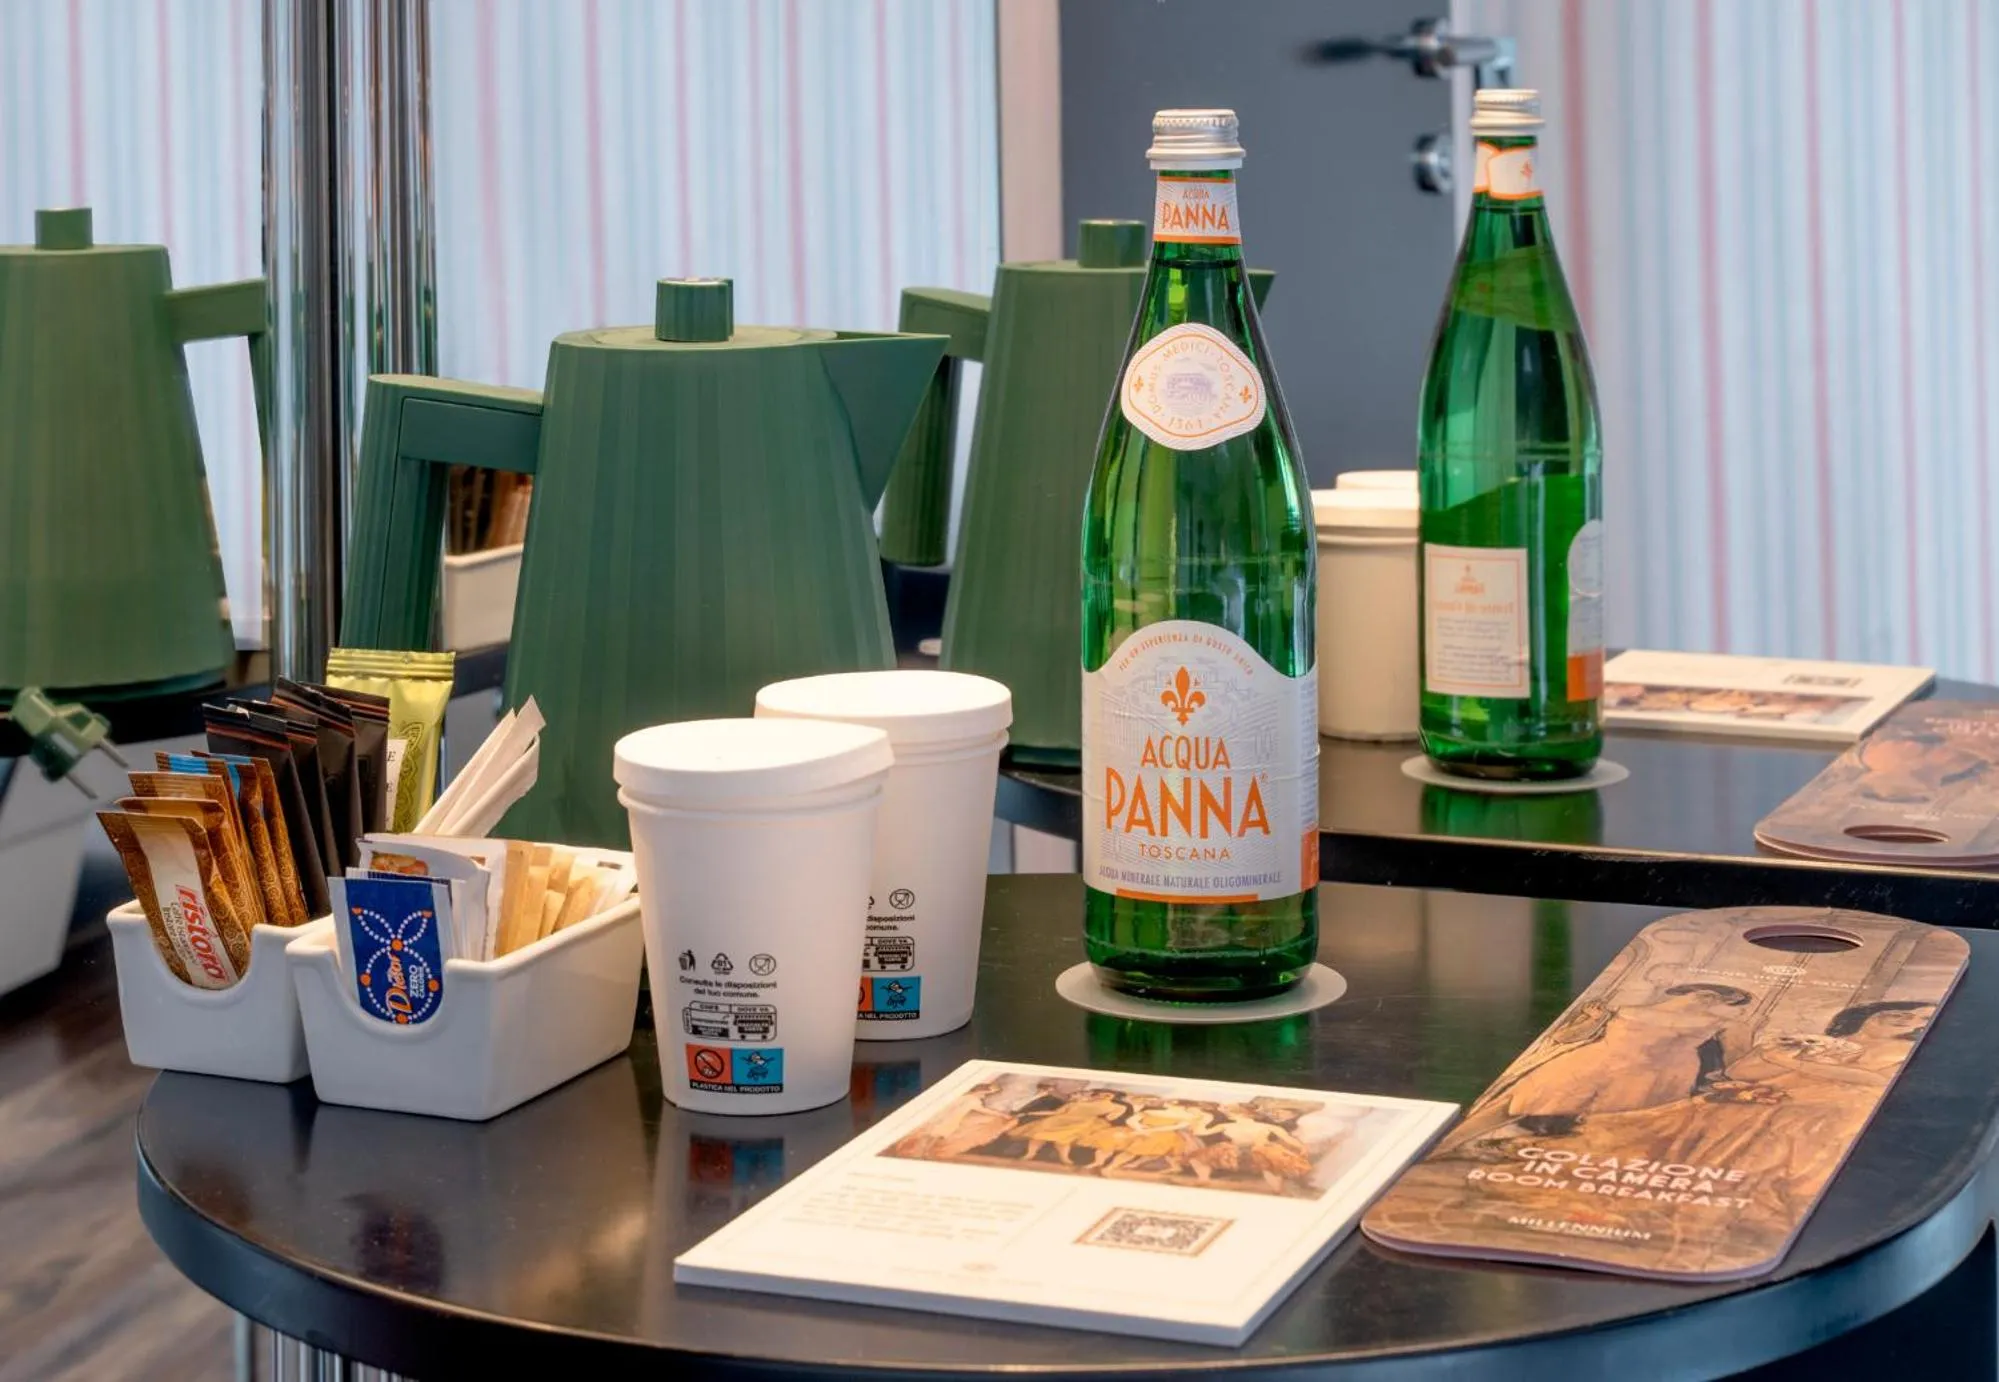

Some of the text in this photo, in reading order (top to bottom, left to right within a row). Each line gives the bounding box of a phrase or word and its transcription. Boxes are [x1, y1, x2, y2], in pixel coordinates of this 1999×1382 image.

[1182, 188, 1210, 200] ACQUA
[1162, 202, 1230, 231] PANNA
[1140, 735, 1232, 770] ACQUA
[1105, 766, 1271, 840] PANNA
[1138, 843, 1232, 862] TOSCANA
[1121, 870, 1160, 887] MINERALE
[1163, 874, 1210, 890] NATURALE
[1213, 870, 1282, 890] OLIGOMINERALE
[408, 964, 419, 998] ZERO
[724, 981, 777, 991] disposizioni
[692, 1082, 723, 1092] PLASTICA
[740, 1086, 781, 1094] PRODOTTO
[1517, 1147, 1747, 1182] COLAZIONE
[1522, 1160, 1714, 1194] IN CAMERA
[1467, 1168, 1754, 1209] ROOM BREAKFAST
[1507, 1215, 1652, 1241] MILLENNIUM
